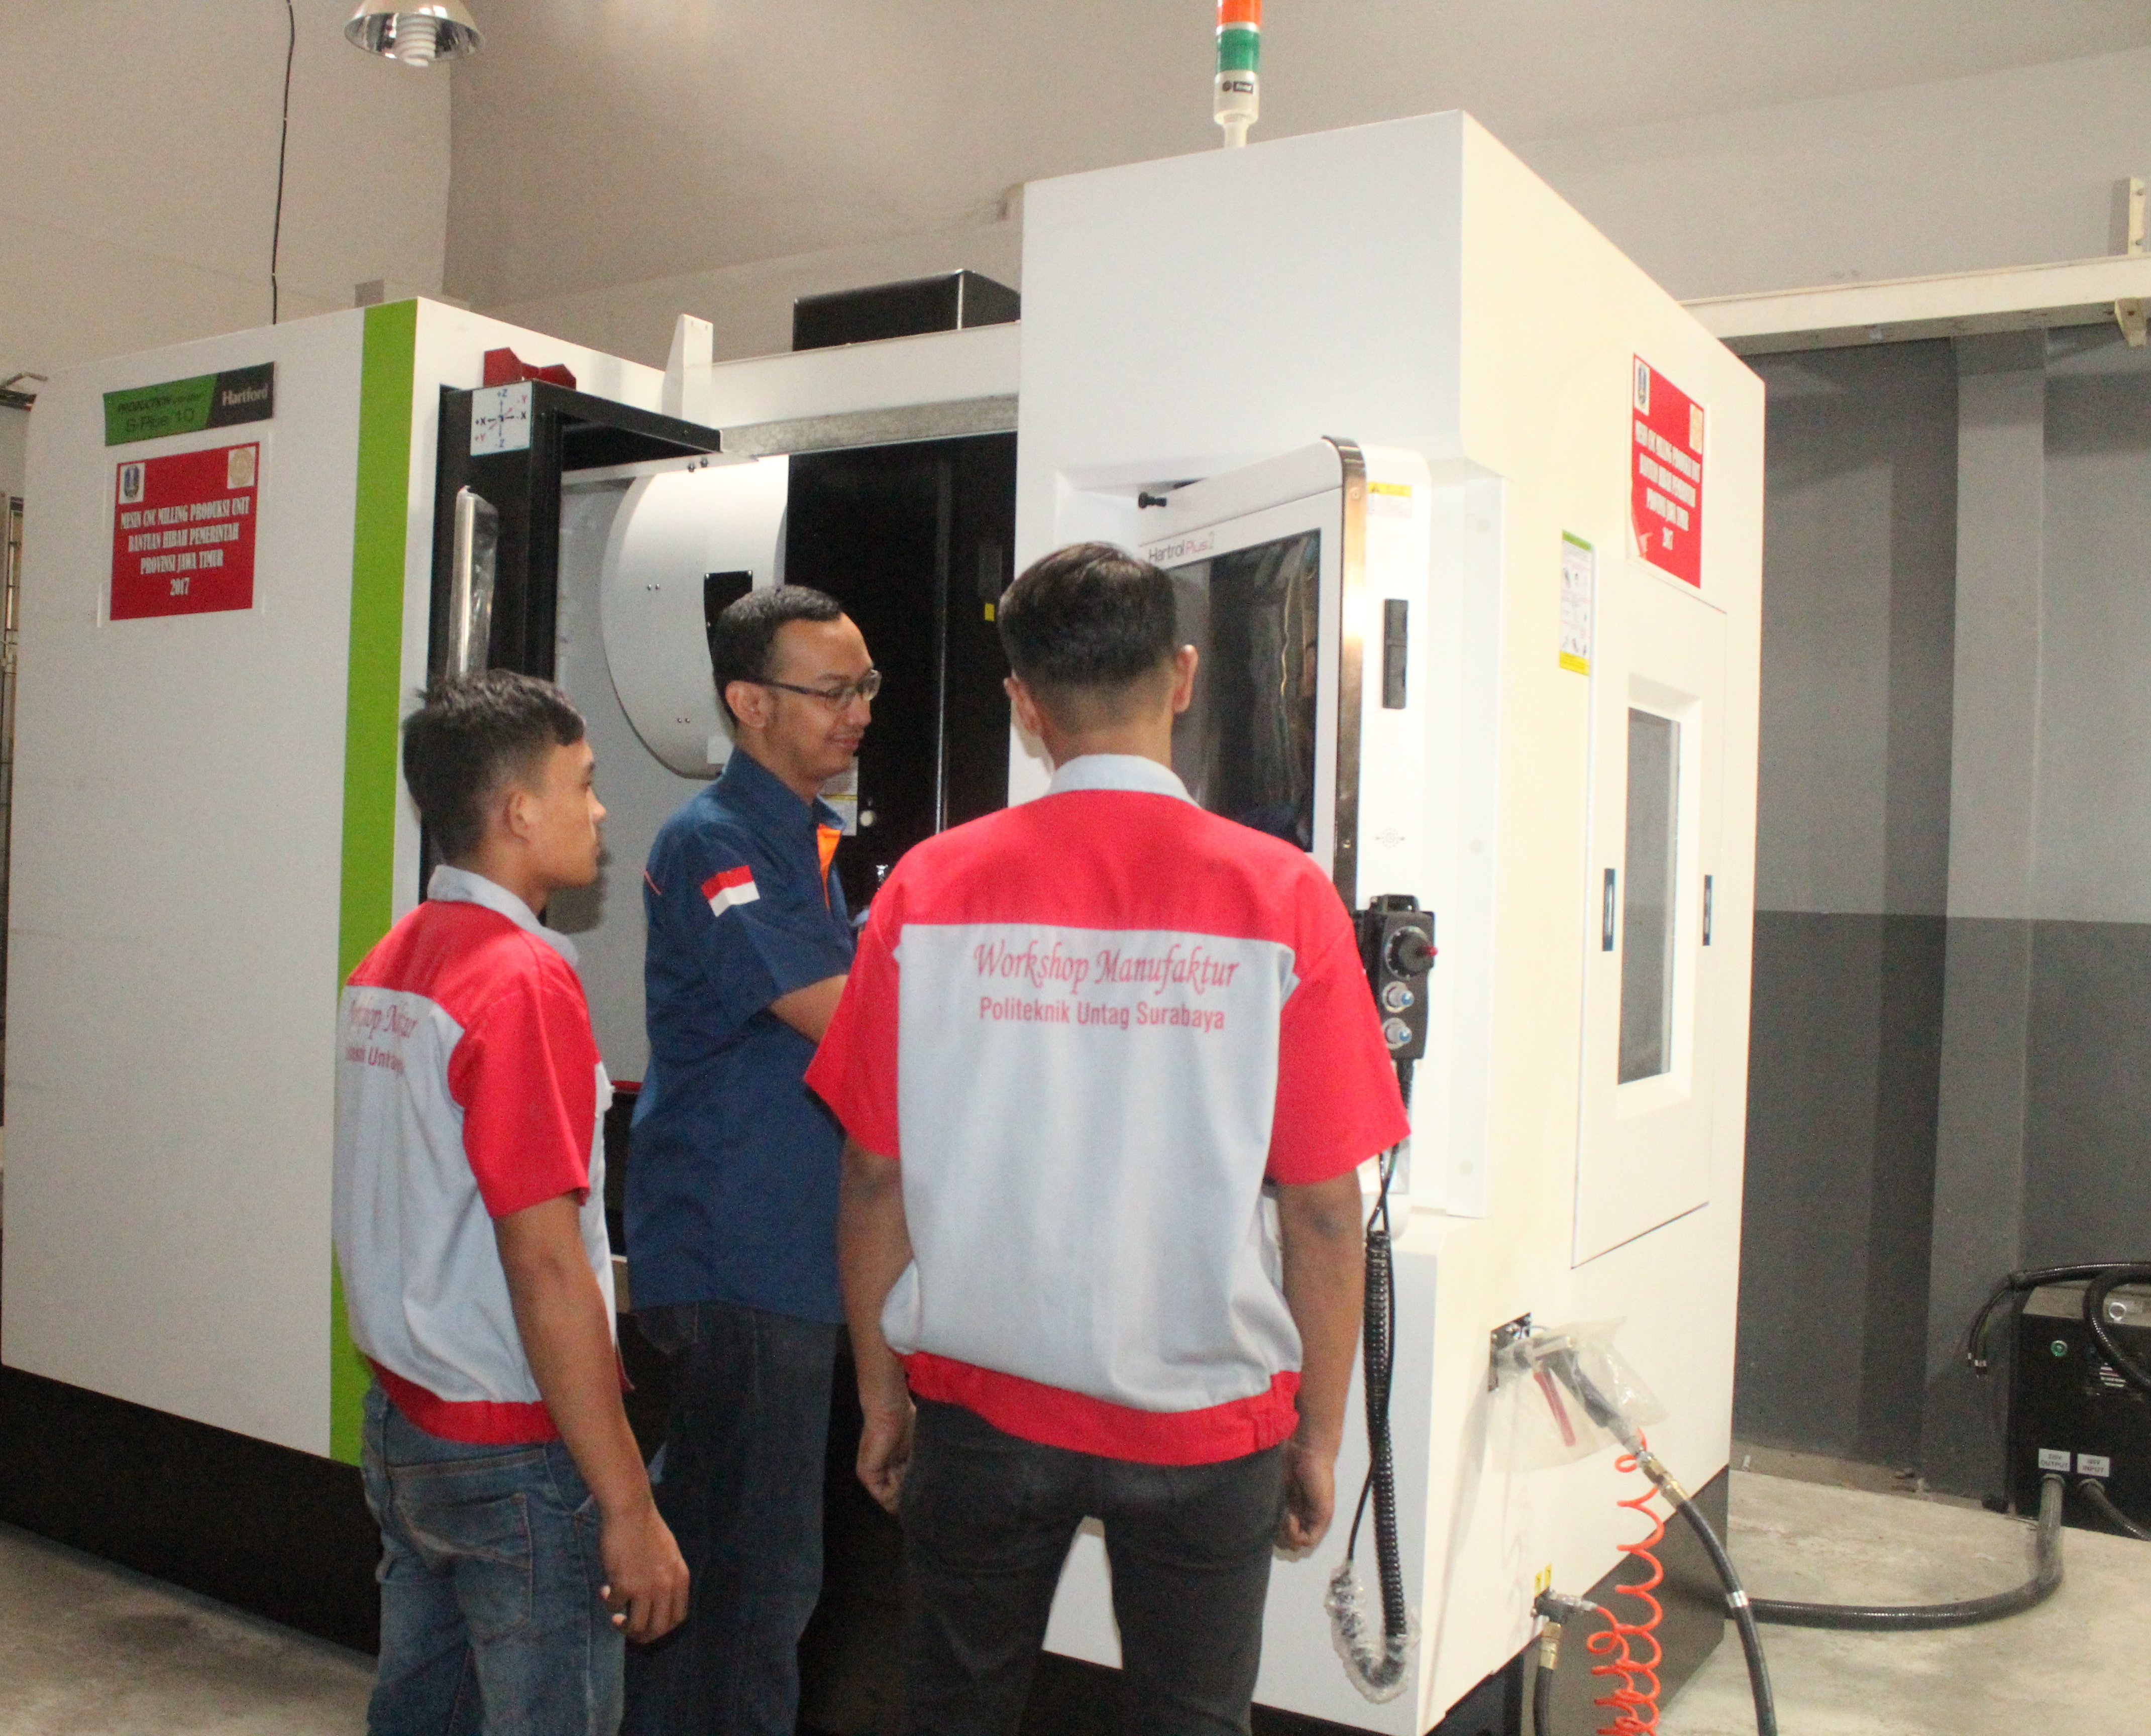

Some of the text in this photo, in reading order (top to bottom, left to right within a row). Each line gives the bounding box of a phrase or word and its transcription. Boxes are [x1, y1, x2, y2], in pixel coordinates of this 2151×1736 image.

[222, 384, 268, 406] Hartford
[158, 505, 188, 524] MILLING
[190, 499, 230, 521] PRODUKSI
[232, 496, 250, 515] UNIT
[128, 522, 239, 552] BANTUAN HIBAH PEMERINTAH
[141, 549, 224, 574] PROVINSI JAWA TIMUR
[170, 577, 189, 596] 2017
[974, 939, 1240, 995] Workshop Manufaktur
[980, 996, 1225, 1033] Politeknik Untag Surabaya
[2040, 1459, 2069, 1468] OUTPUT
